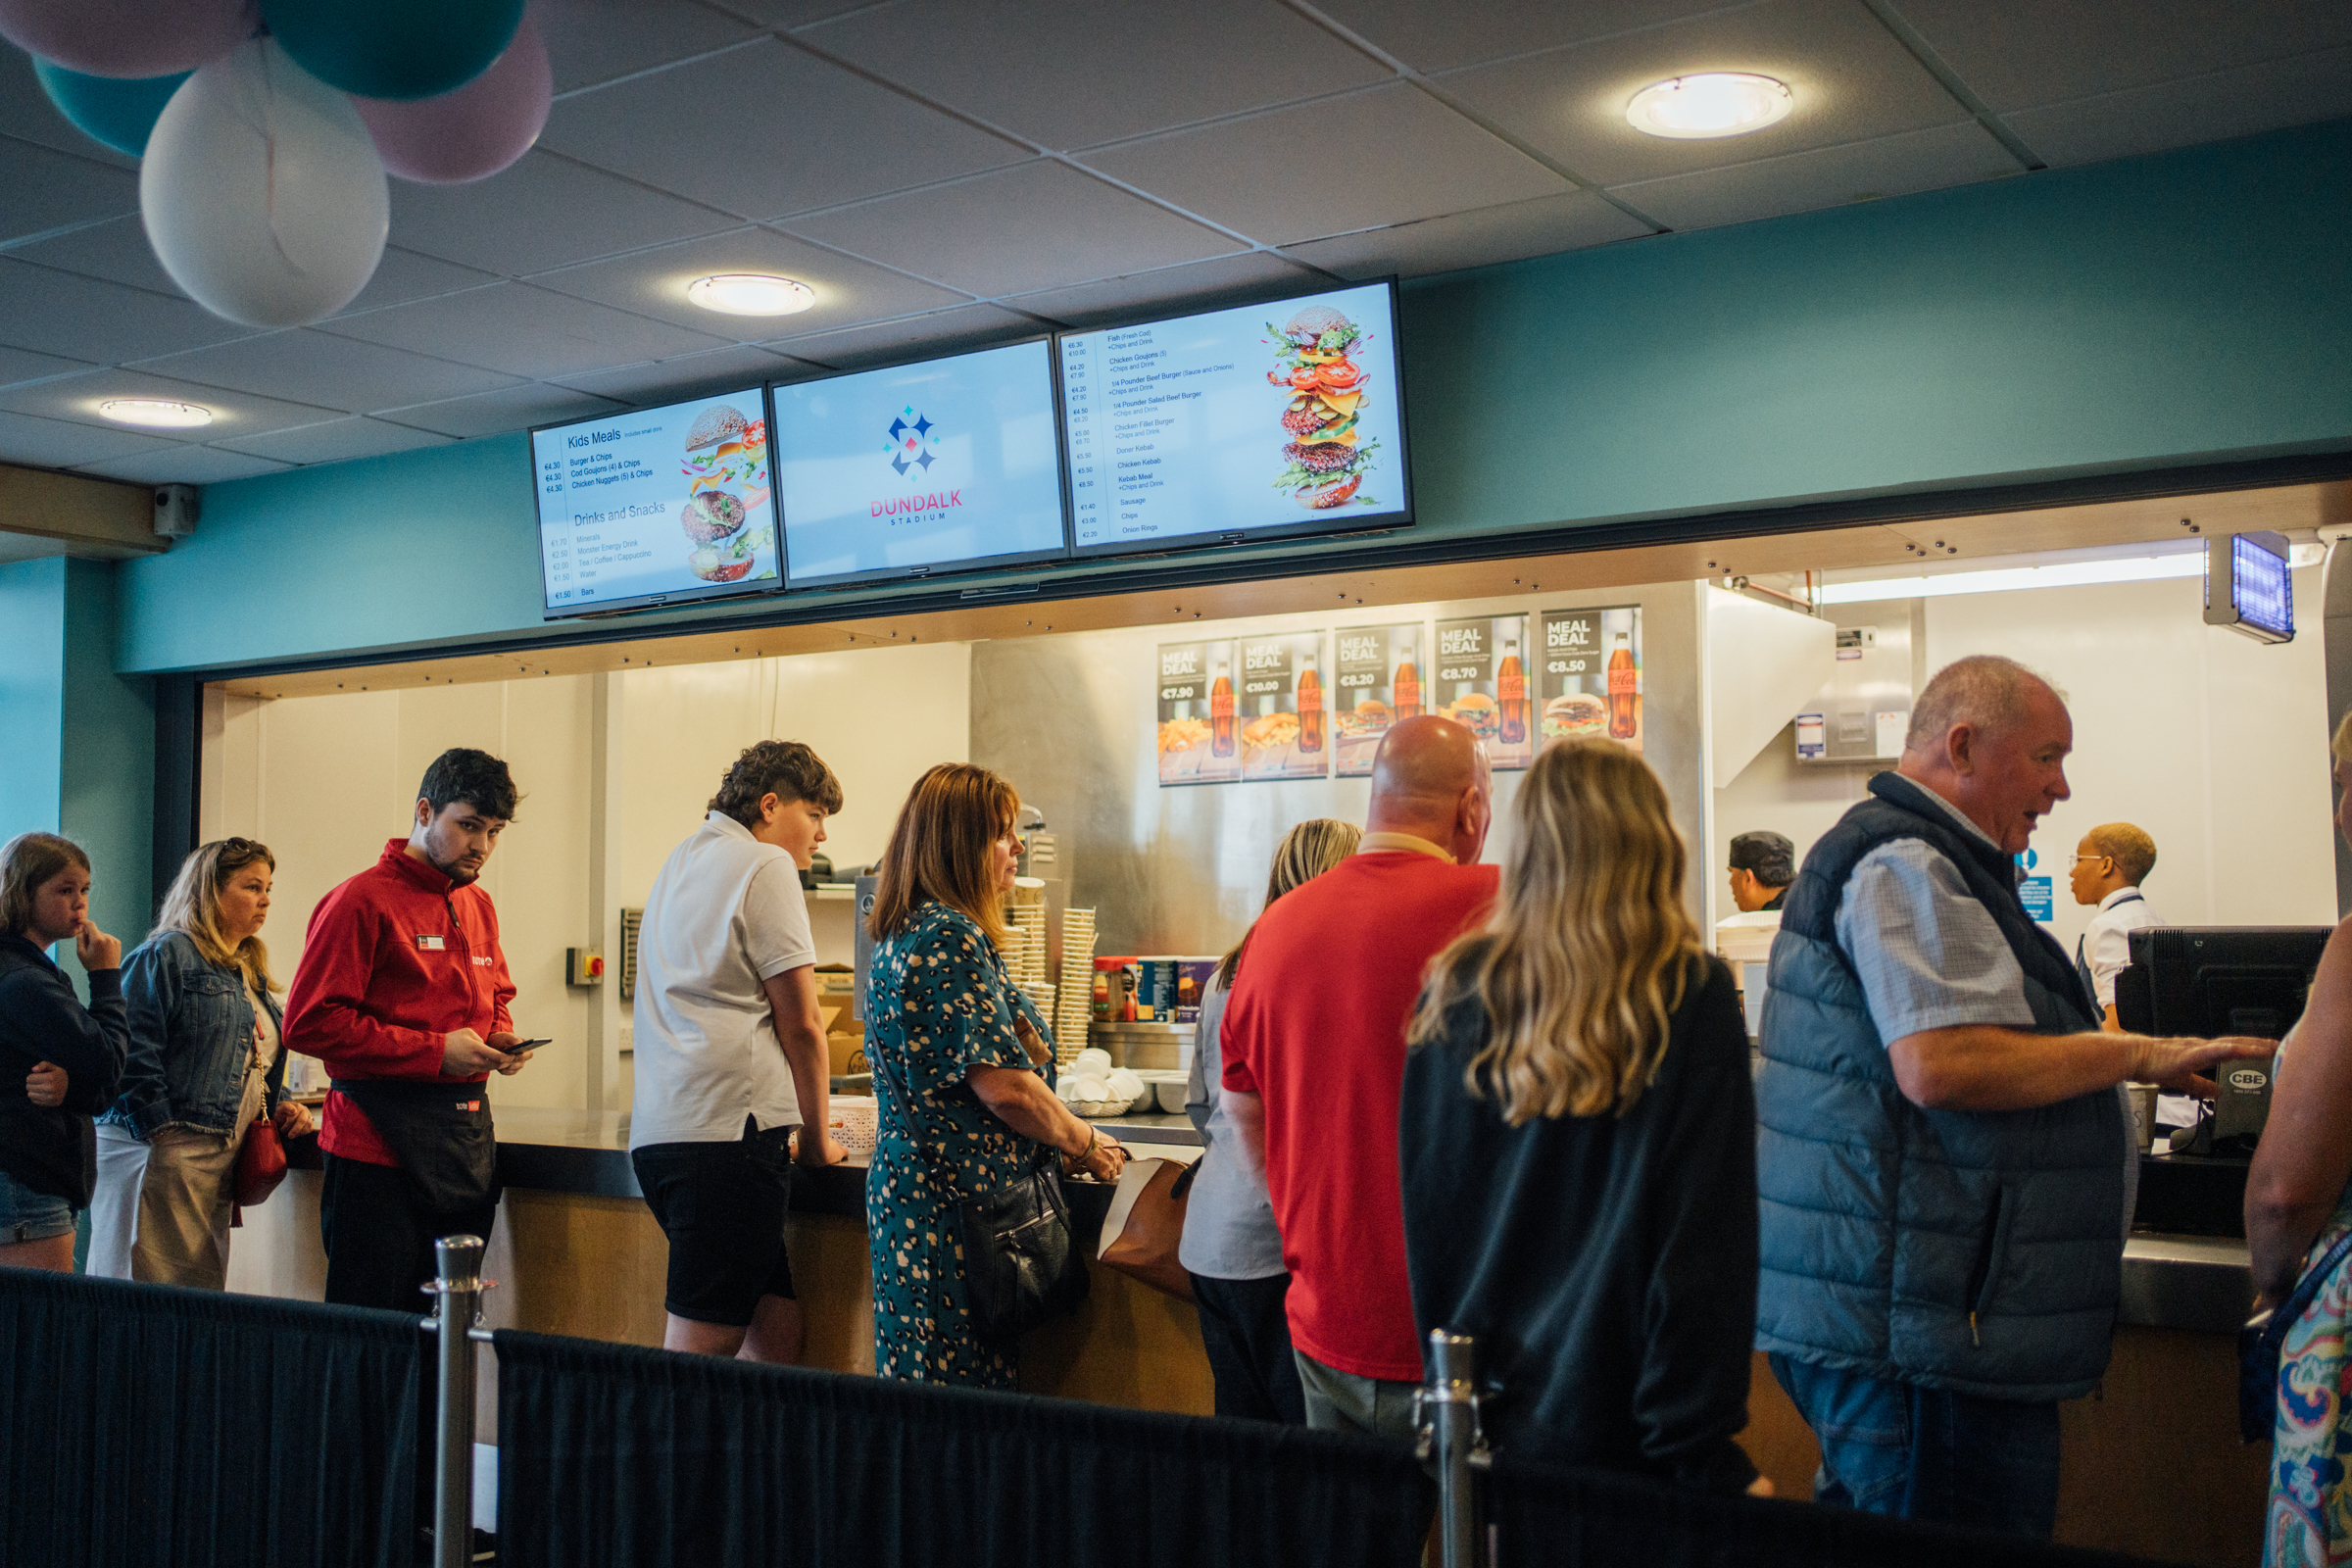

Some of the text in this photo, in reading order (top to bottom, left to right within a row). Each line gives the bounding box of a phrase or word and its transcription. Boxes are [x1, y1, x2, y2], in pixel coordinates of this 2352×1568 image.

[1121, 332, 1137, 341] (Fresh
[1139, 329, 1152, 338] Cod)
[1107, 340, 1128, 351] +Chips
[1140, 337, 1153, 346] Drink
[1109, 356, 1133, 365] Chicken
[1134, 351, 1158, 362] Goujons
[1109, 364, 1128, 373] +Chips
[1120, 375, 1145, 386] Pounder
[1147, 373, 1160, 382] Beef
[1161, 370, 1181, 381] Burger
[1108, 387, 1128, 397] +Chips
[1140, 383, 1153, 392] Drink
[1122, 399, 1147, 408] Pounder
[1148, 395, 1165, 404] Salad
[1166, 392, 1181, 401] Beef
[1182, 390, 1201, 400] Burger
[1113, 409, 1132, 417] +Chips
[1155, 417, 1175, 427] Burger
[568, 434, 589, 449] Kids
[592, 428, 621, 444] Meals
[1136, 443, 1154, 452] Kebab
[545, 462, 561, 470] €4.30
[570, 457, 589, 466] Burger
[596, 453, 612, 462] Chips
[570, 468, 582, 477] Cod
[584, 466, 607, 475] Goujons
[624, 460, 640, 468] Chips
[546, 472, 562, 482] €4.30
[571, 479, 595, 489] Chicken
[596, 474, 619, 485] Nuggets
[636, 468, 653, 478] Chips
[547, 484, 563, 493] €4.30
[870, 489, 962, 517] DUNDALK
[575, 502, 665, 526] Drinks and Snacks
[891, 513, 946, 525] STADIUM
[552, 538, 566, 547] €1.70
[577, 533, 601, 543] Minerals
[553, 550, 567, 559] €2.50
[577, 545, 600, 555] Monster
[602, 542, 621, 552] Energy
[594, 556, 612, 564] Coffee
[617, 550, 652, 562] Cappuccino
[553, 562, 568, 570] €2.00
[554, 573, 569, 582] €1.50
[579, 569, 597, 578] Water
[556, 590, 571, 599] €1.50
[1547, 620, 1591, 634] MEAL
[1441, 628, 1482, 642] MEAL
[1547, 632, 1589, 647] DEAL
[1341, 636, 1379, 650] MEAL
[1441, 641, 1480, 655] DEAL
[1162, 651, 1198, 664] MEAL
[1246, 645, 1283, 658] MEAL
[1341, 648, 1377, 662] DEAL
[1162, 662, 1196, 675] DEAL
[1246, 657, 1281, 669] DEAL
[1547, 660, 1586, 673] €8.50
[1340, 673, 1374, 686] €8.20
[1441, 667, 1477, 680] €8.70
[1162, 686, 1194, 700] €7.90
[1246, 681, 1279, 693] €10.00
[2232, 1074, 2263, 1084] CBE
